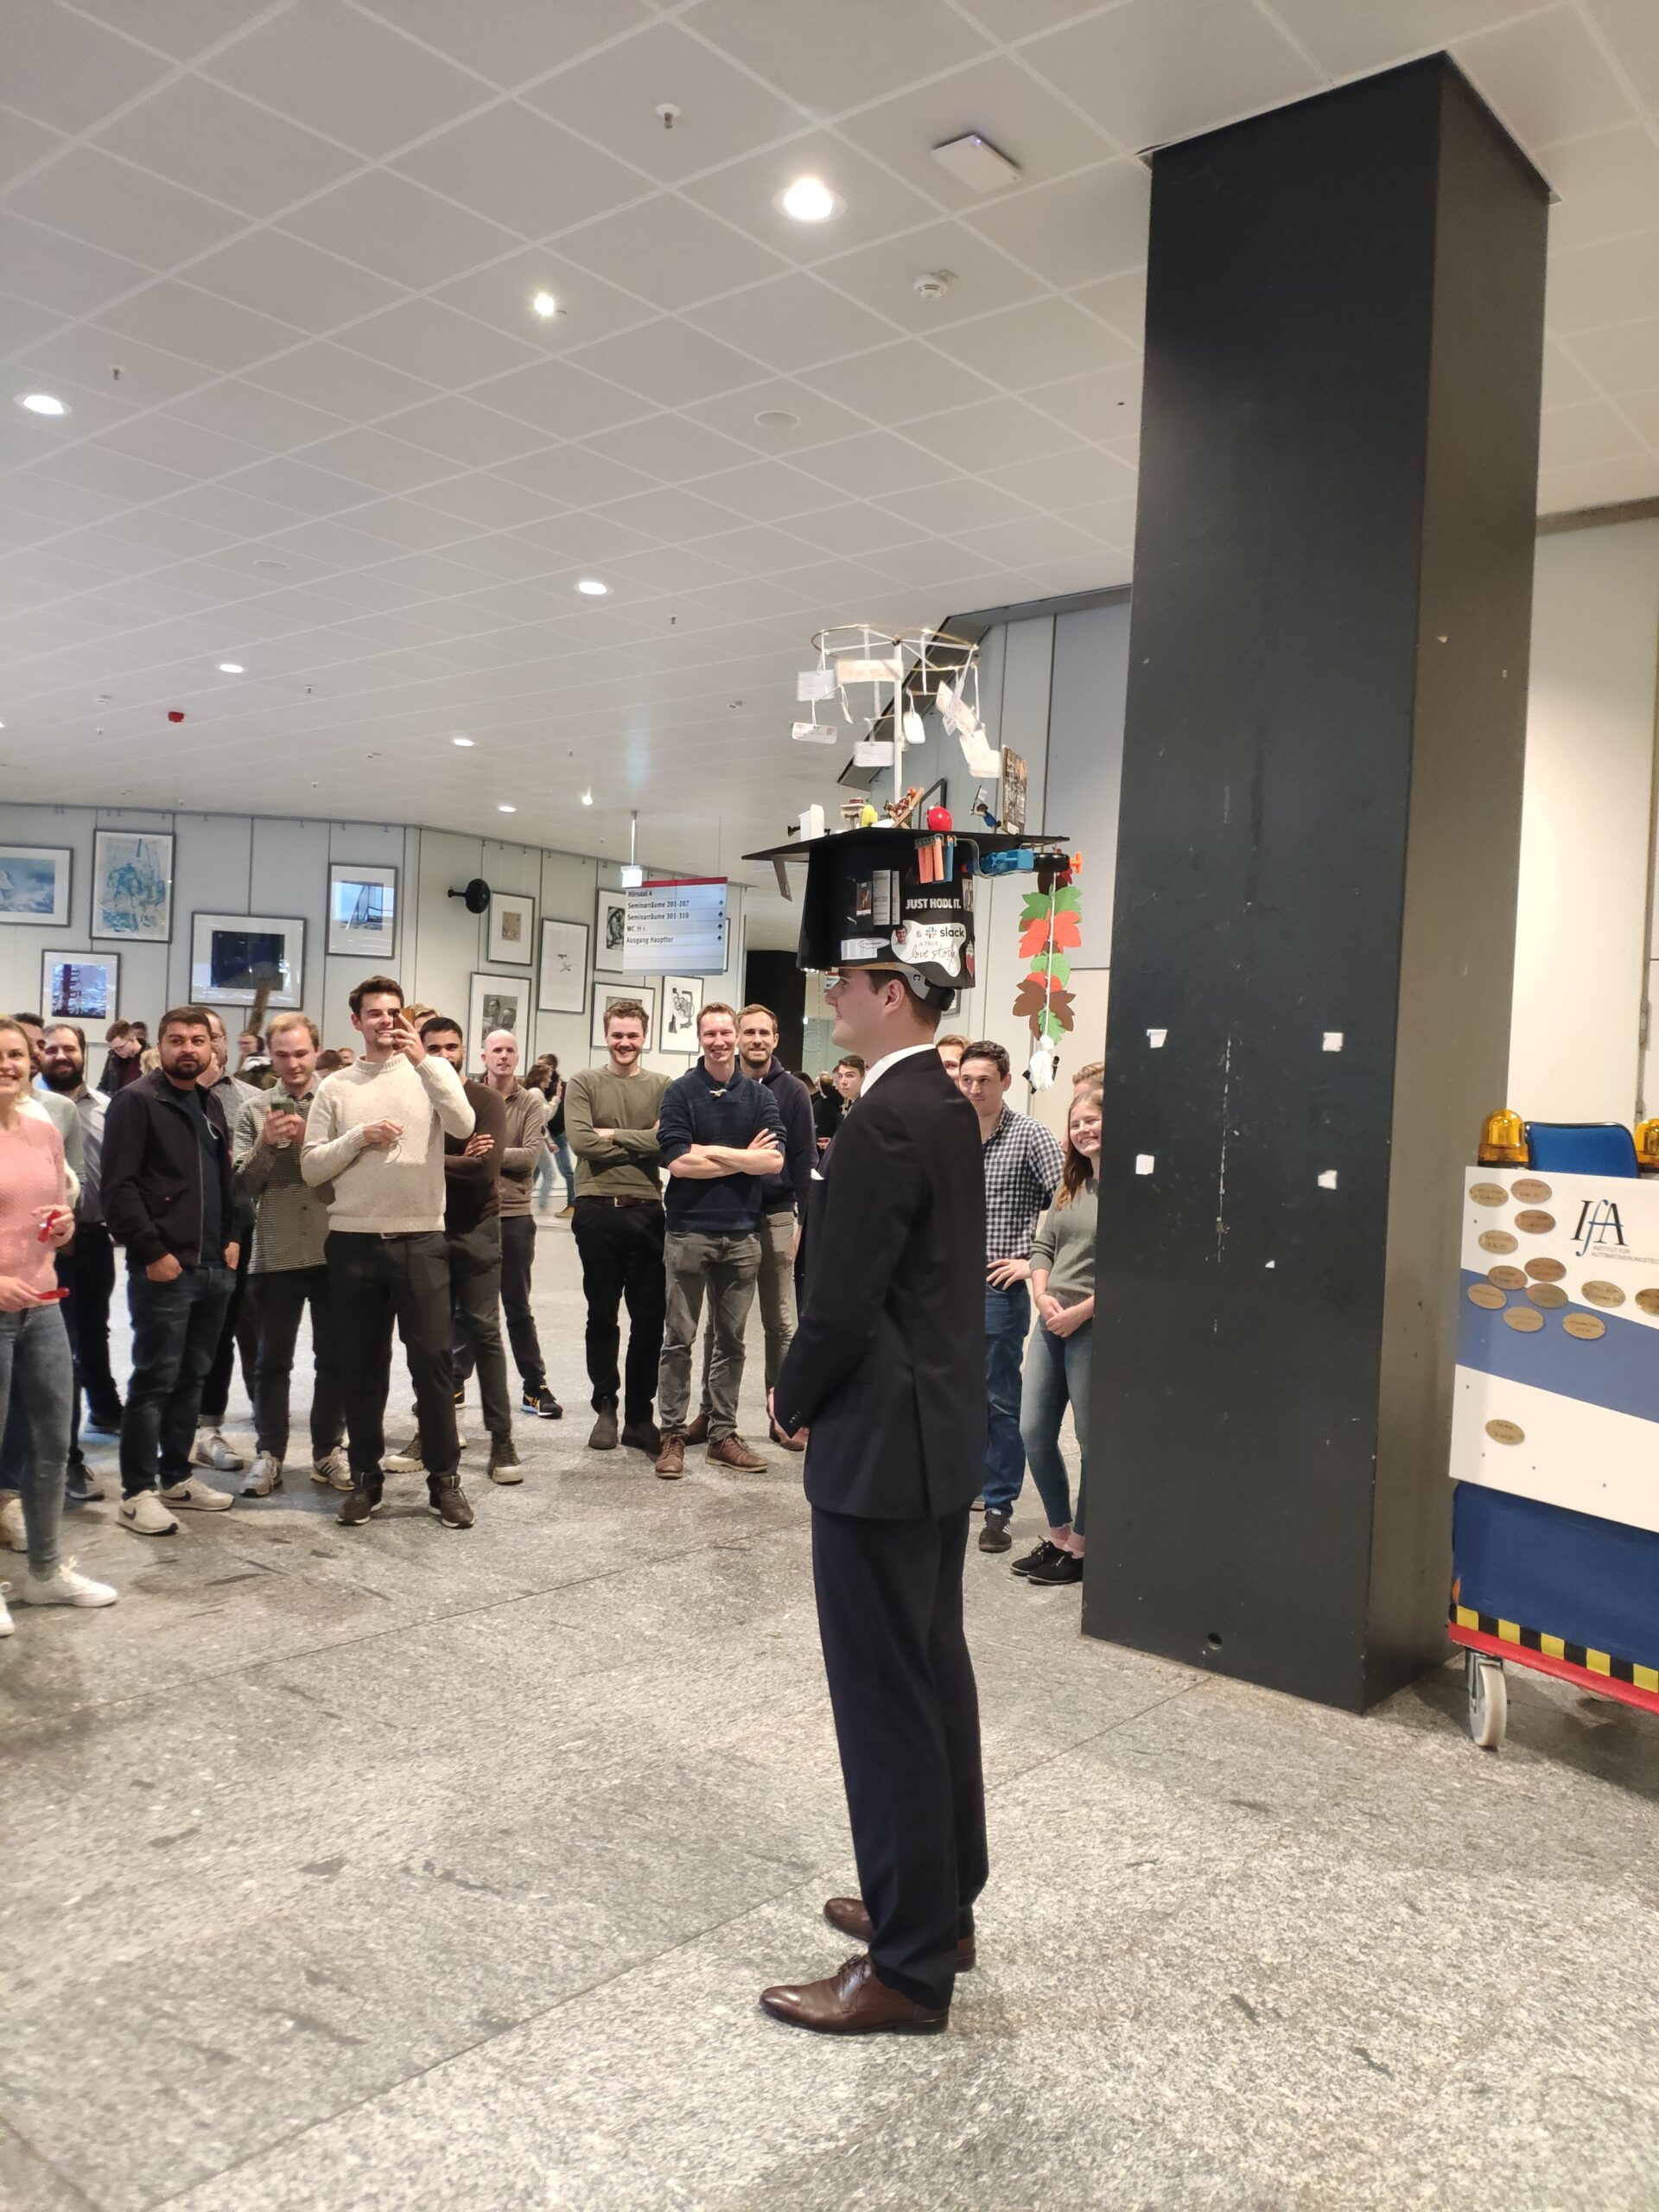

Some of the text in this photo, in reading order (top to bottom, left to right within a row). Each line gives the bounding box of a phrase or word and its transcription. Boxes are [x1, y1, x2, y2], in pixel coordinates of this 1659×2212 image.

[906, 899, 929, 909] JUST
[930, 898, 953, 909] HODL
[940, 926, 965, 938] slack
[905, 944, 930, 963] love
[932, 943, 957, 975] story
